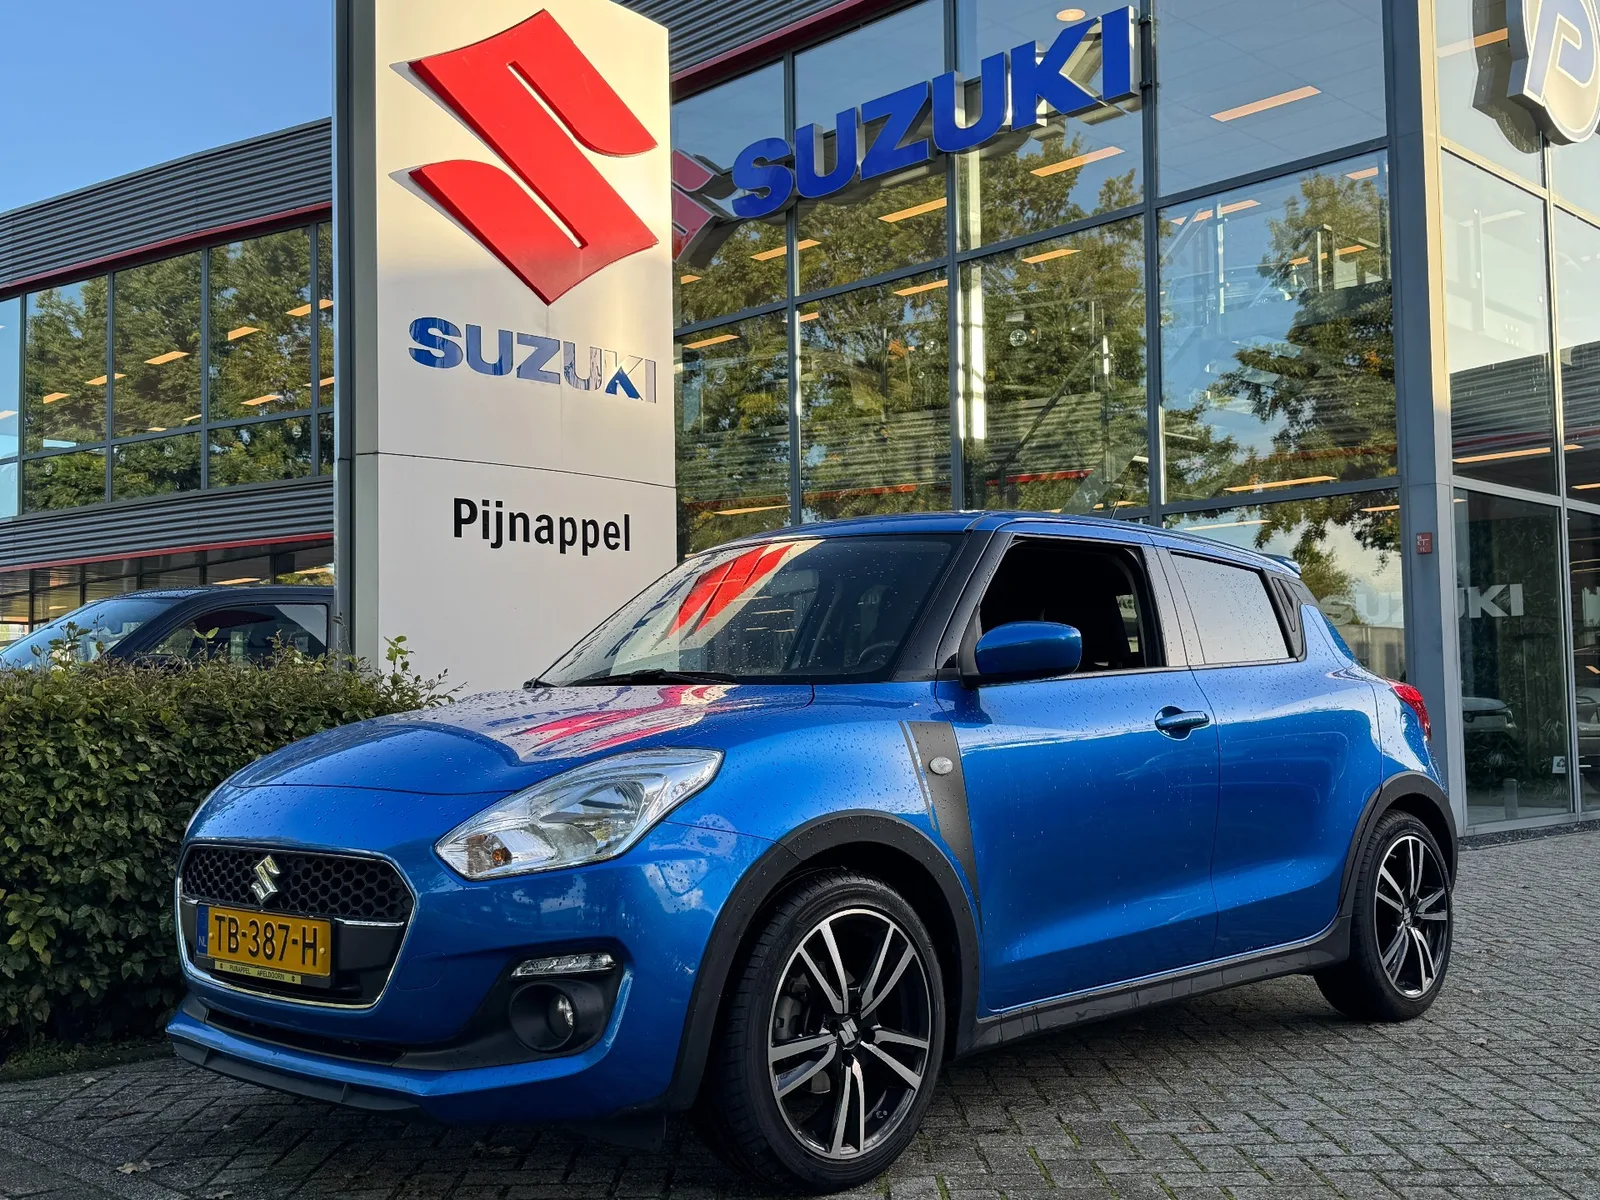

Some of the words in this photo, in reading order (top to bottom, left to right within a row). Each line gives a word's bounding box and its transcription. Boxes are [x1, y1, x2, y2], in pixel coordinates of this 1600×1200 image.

[731, 5, 1138, 219] SUZUKI
[407, 316, 657, 404] SUZUKI
[453, 497, 631, 556] Pijnappel
[1319, 583, 1525, 627] SUKI
[214, 913, 319, 967] TB-387-H
[256, 969, 285, 981] APELDOORN
